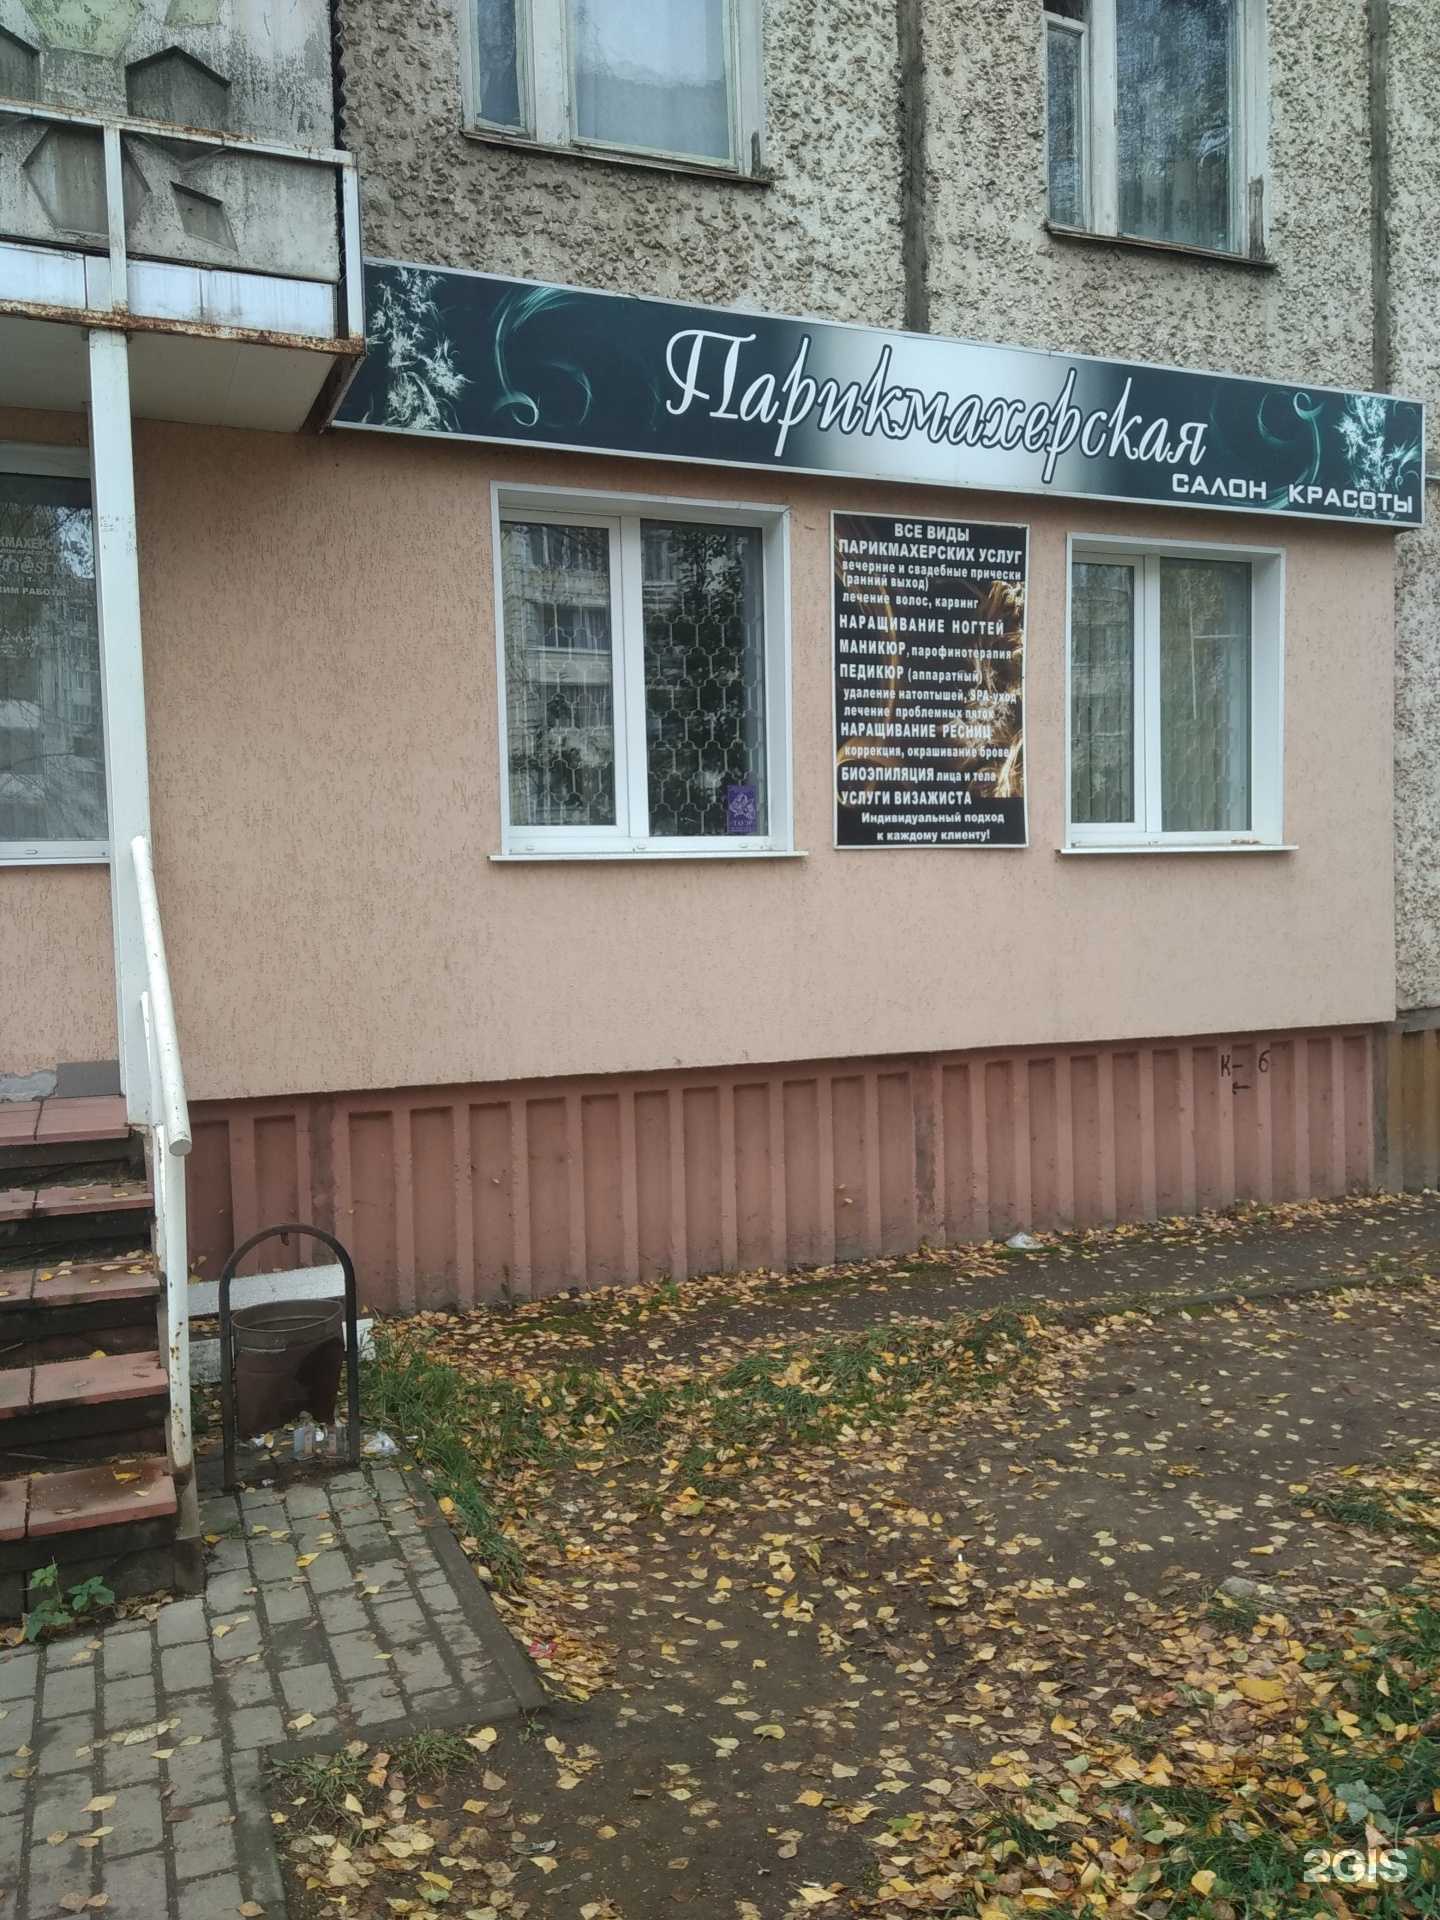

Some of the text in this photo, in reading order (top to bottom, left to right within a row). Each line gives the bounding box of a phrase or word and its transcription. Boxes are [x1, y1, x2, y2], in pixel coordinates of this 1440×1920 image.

[665, 328, 1208, 484] Парикмахерская
[1172, 473, 1412, 513] САЛОН КРАСОТЫ
[895, 523, 969, 542] ВСЕ ВИДЫ
[839, 539, 1022, 564] ПАРИКМАХЕРСКИХ УСЛУГ
[842, 561, 895, 573] вечерние
[908, 565, 967, 577] свадебные
[971, 570, 1021, 581] прически
[843, 572, 928, 591] (ранний выход)
[843, 592, 978, 610] лечение волос, карвинг
[840, 614, 1004, 635] НАРАЩИВАНИЕ НОГТЕЙ
[840, 639, 909, 658] МАНИКЮР,
[840, 664, 982, 683] ПЕДИКЮР (аппаратный)
[843, 688, 895, 700] удаление
[899, 688, 967, 703] натоптышей,
[844, 706, 890, 717] лечение
[896, 706, 962, 720] проблемных
[841, 722, 992, 739] НАРАЩИВАНИЕ РЕСНИЦ
[845, 746, 1011, 758] коррекция, окрашивание брове
[842, 767, 996, 782] БИОЭПИЛЯЦИЯ лица и тела
[841, 791, 972, 804] УСЛУГИ ВИЗАЖИСТА
[862, 812, 1004, 824] Индивидуальный подход
[877, 829, 990, 842] к каждому клиенту!
